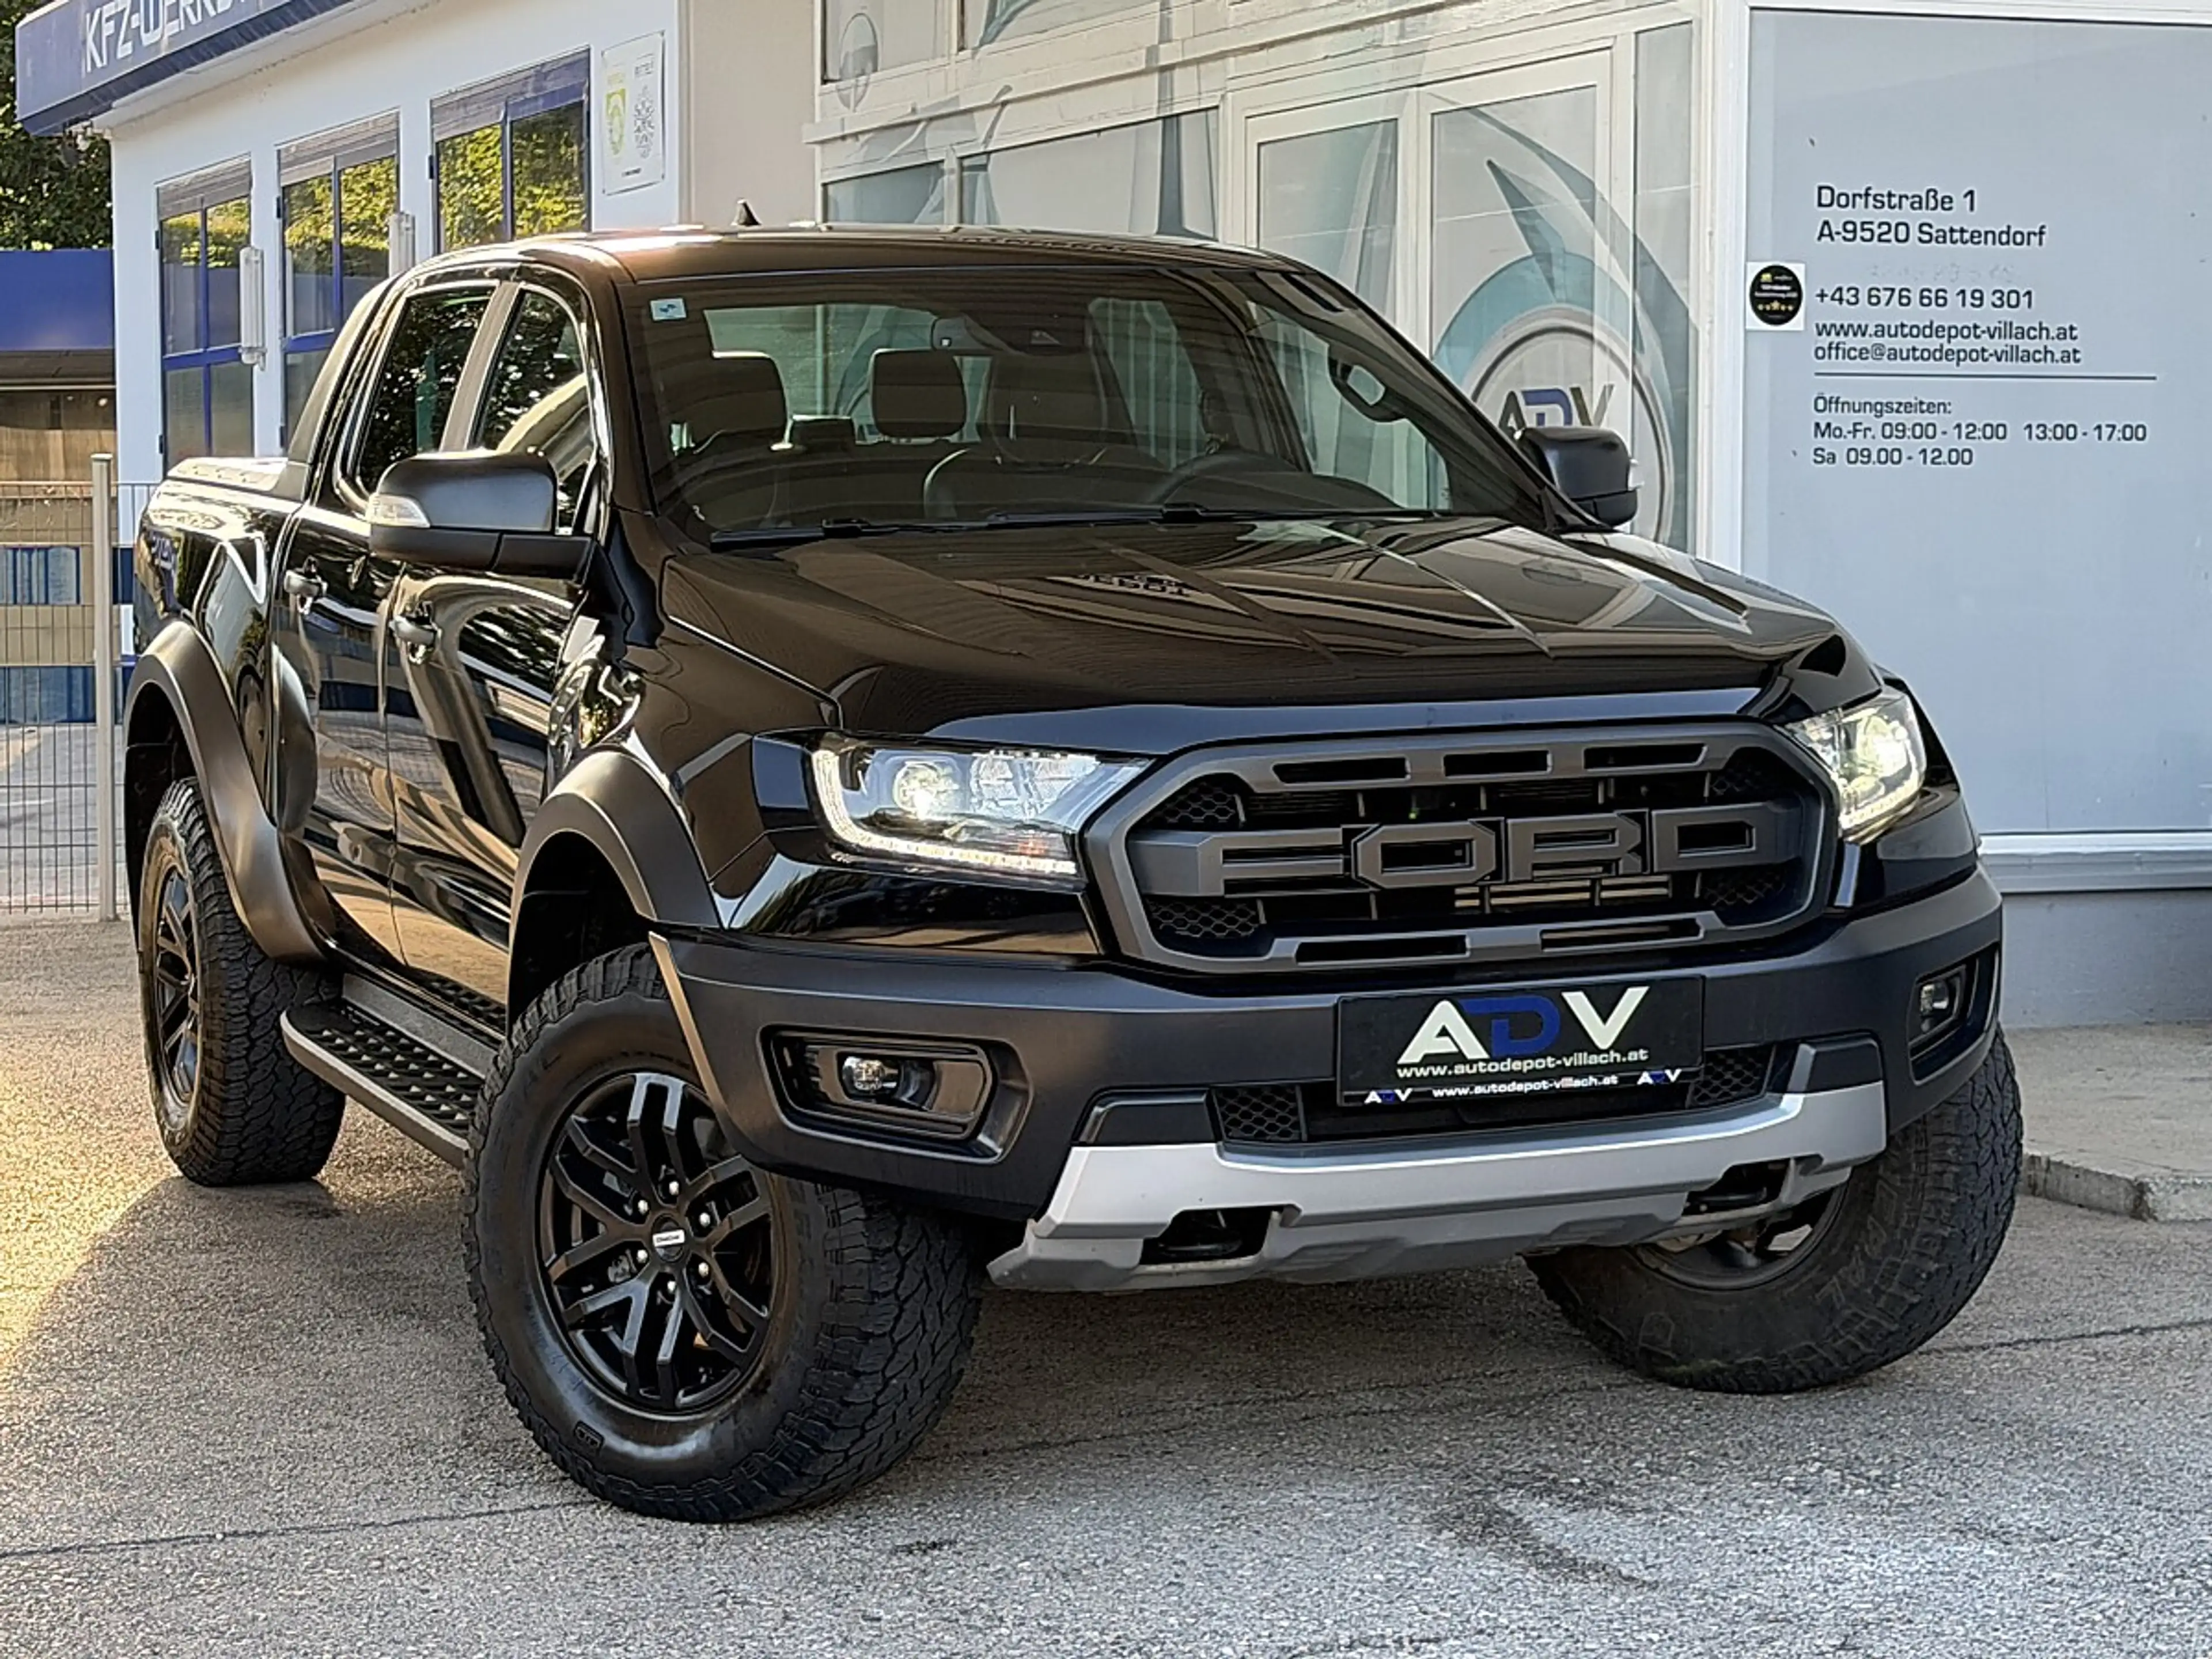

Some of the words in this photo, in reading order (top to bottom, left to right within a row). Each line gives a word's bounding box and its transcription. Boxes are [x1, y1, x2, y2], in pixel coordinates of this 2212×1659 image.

[86, 0, 244, 73] KFZ-WER
[1817, 185, 1953, 212] Dorfstraße
[1963, 190, 1975, 212] 1
[1817, 219, 1910, 244] A-9520
[1918, 222, 2046, 247] Sattendorf
[1815, 286, 1859, 306] +43
[1867, 287, 1911, 307] 676
[1919, 287, 1948, 308] 66
[1956, 289, 1984, 308] 19
[1991, 289, 2032, 309] 301
[1815, 320, 2078, 344] www.autodepot-villach.at
[1814, 342, 2081, 367] office@autodepot-villach.at
[1814, 393, 1952, 418] Öffnungszeiten:
[1814, 422, 1876, 440] Mo.-Fr.
[1881, 422, 1937, 440] 09:00
[1953, 423, 2007, 440] 12:00
[2024, 423, 2078, 441] 13:00
[2093, 423, 2147, 441] 17:00
[1813, 447, 1836, 465] Sa
[1846, 448, 1902, 465] 09.00
[1918, 448, 1973, 465] 12.00
[1198, 806, 1759, 897] FORD
[1397, 986, 1649, 1064] ADV
[1396, 1048, 1649, 1079] www.autodepot-villach.at
